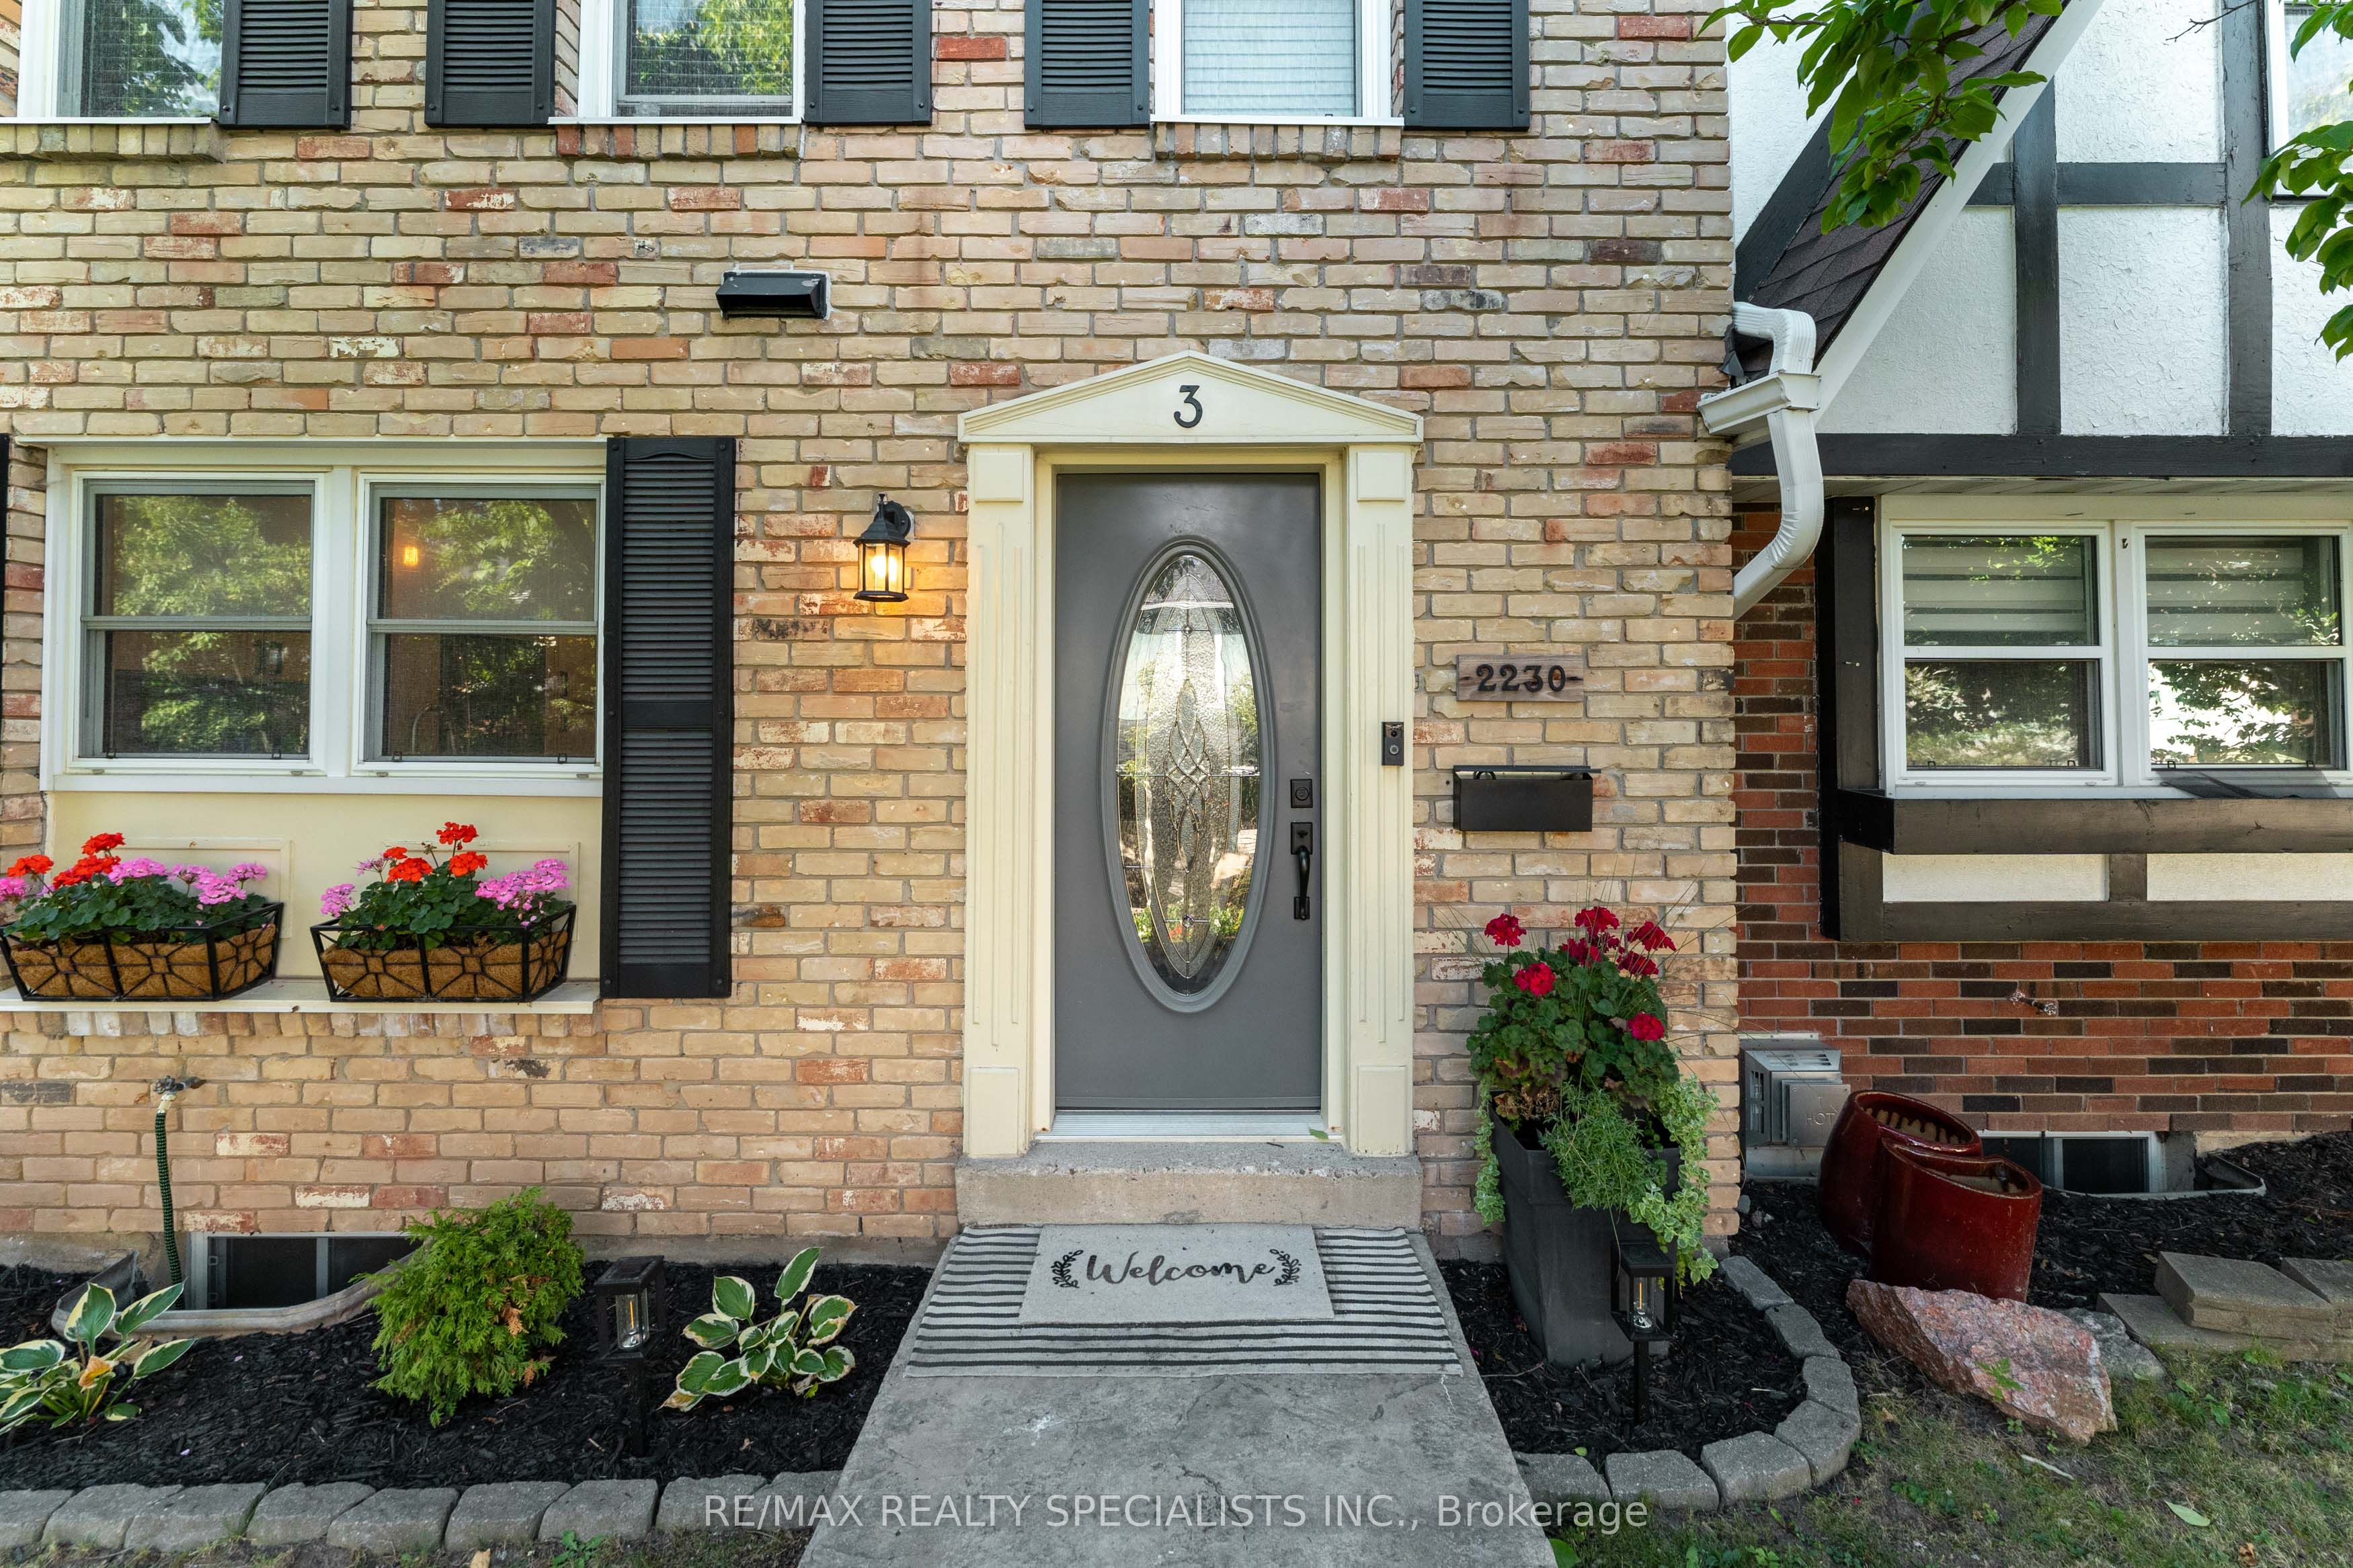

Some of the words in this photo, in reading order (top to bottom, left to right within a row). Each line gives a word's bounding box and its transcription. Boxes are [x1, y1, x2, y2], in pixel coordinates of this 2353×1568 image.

[1174, 384, 1203, 428] 3
[1476, 664, 1566, 692] 2230
[1803, 1112, 1835, 1125] HOT
[1086, 1251, 1275, 1286] Welcome
